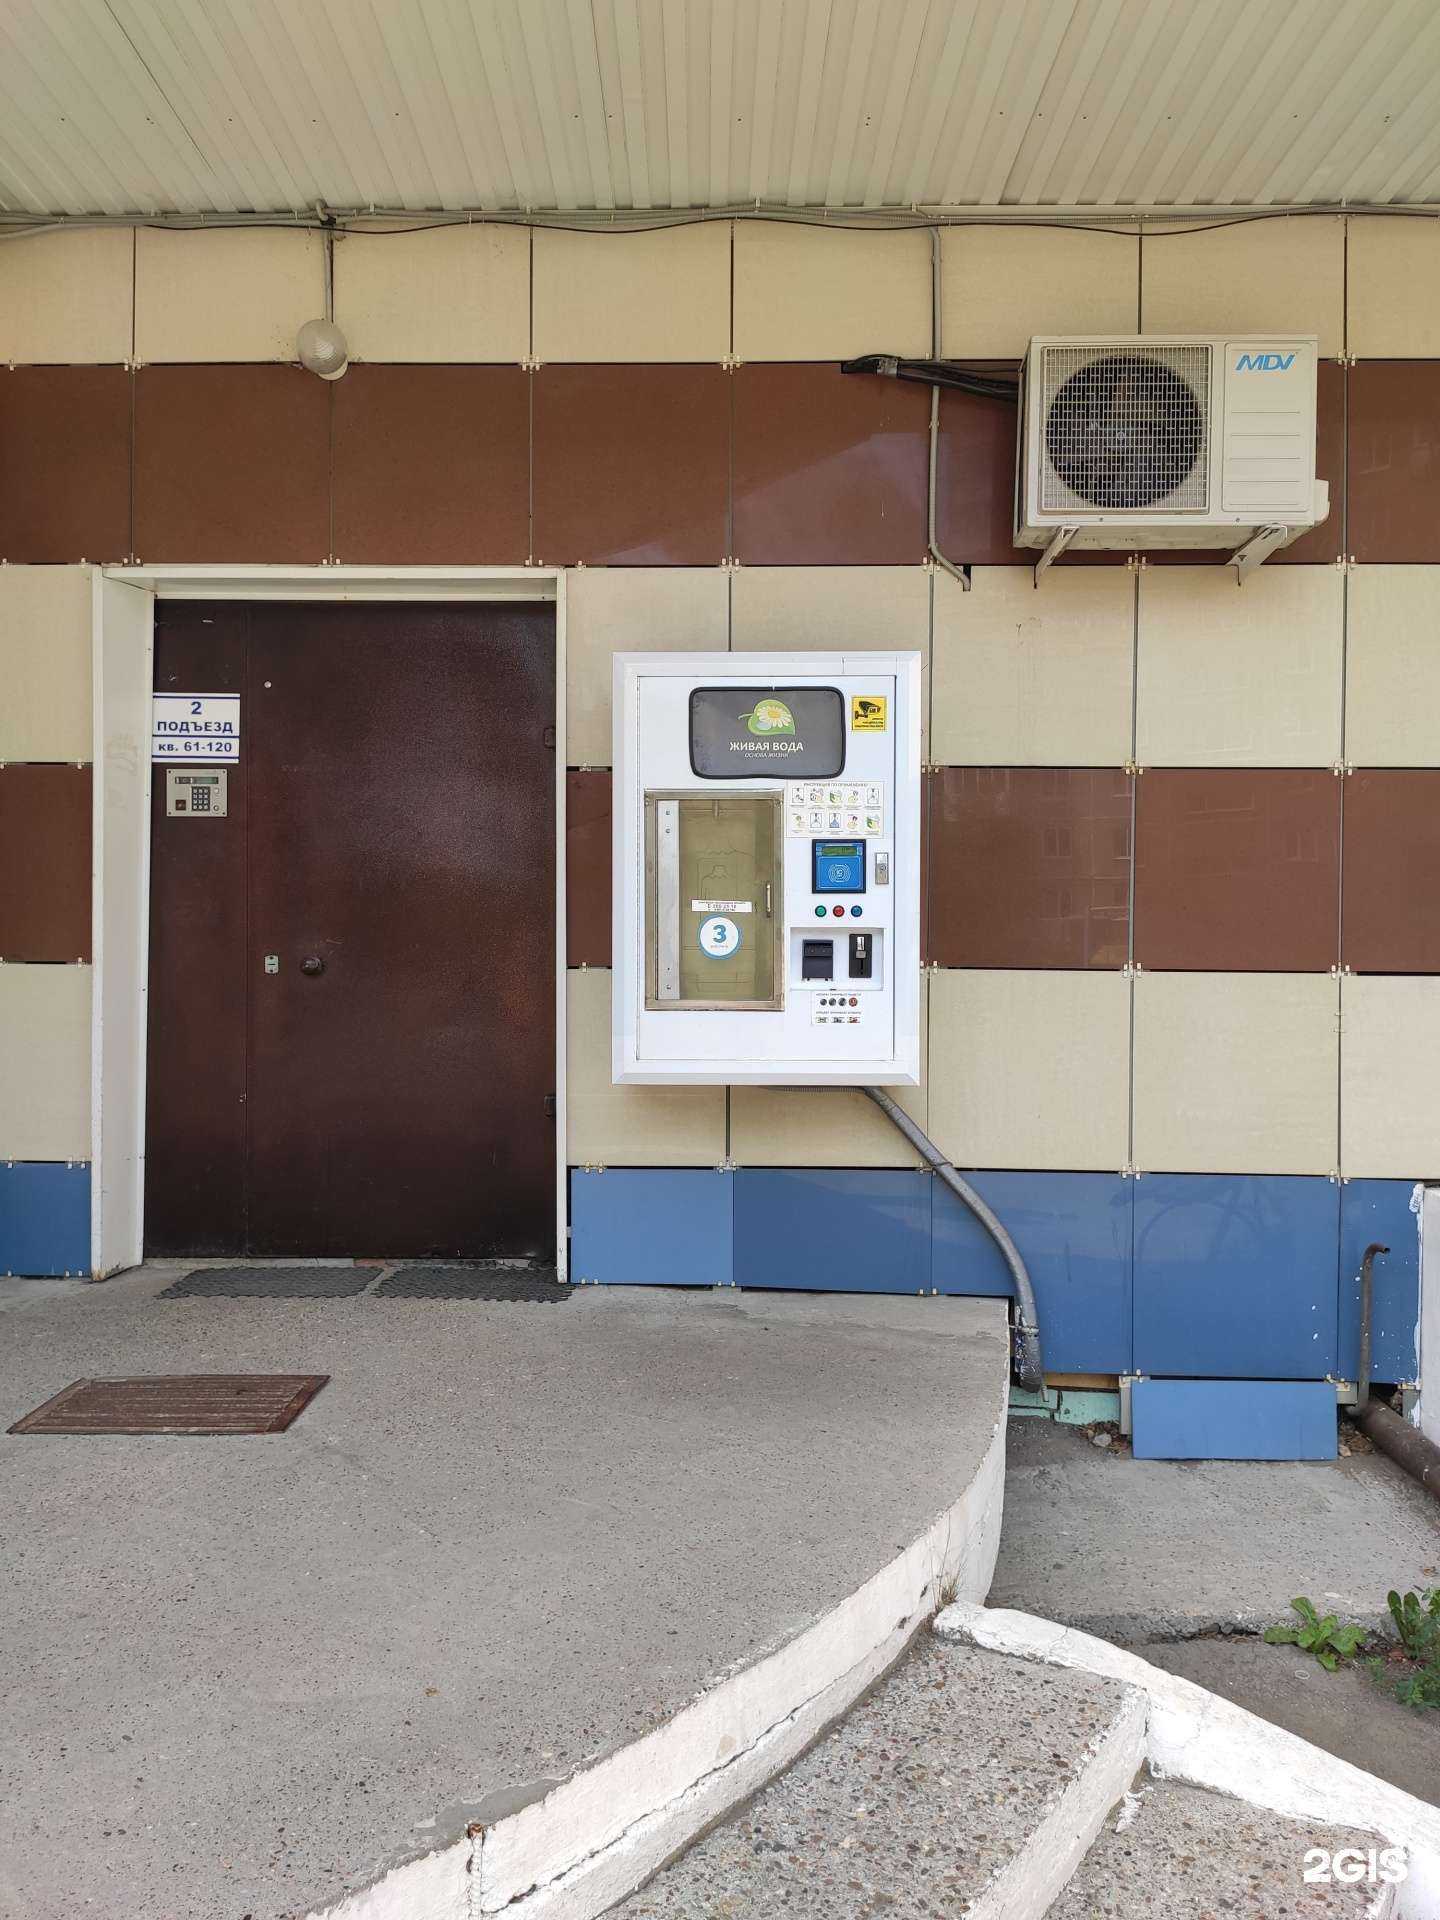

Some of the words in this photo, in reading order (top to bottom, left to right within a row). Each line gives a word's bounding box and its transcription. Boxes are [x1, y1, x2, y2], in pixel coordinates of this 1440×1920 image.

[1235, 354, 1296, 371] MDV
[191, 701, 202, 715] 2
[157, 721, 233, 734] ПОДЪЕЗД
[158, 743, 179, 752] кв.
[184, 741, 232, 752] 61-120
[729, 742, 770, 751] ЖИВАЯ
[772, 742, 804, 752] ВОДА
[712, 924, 727, 943] 3
